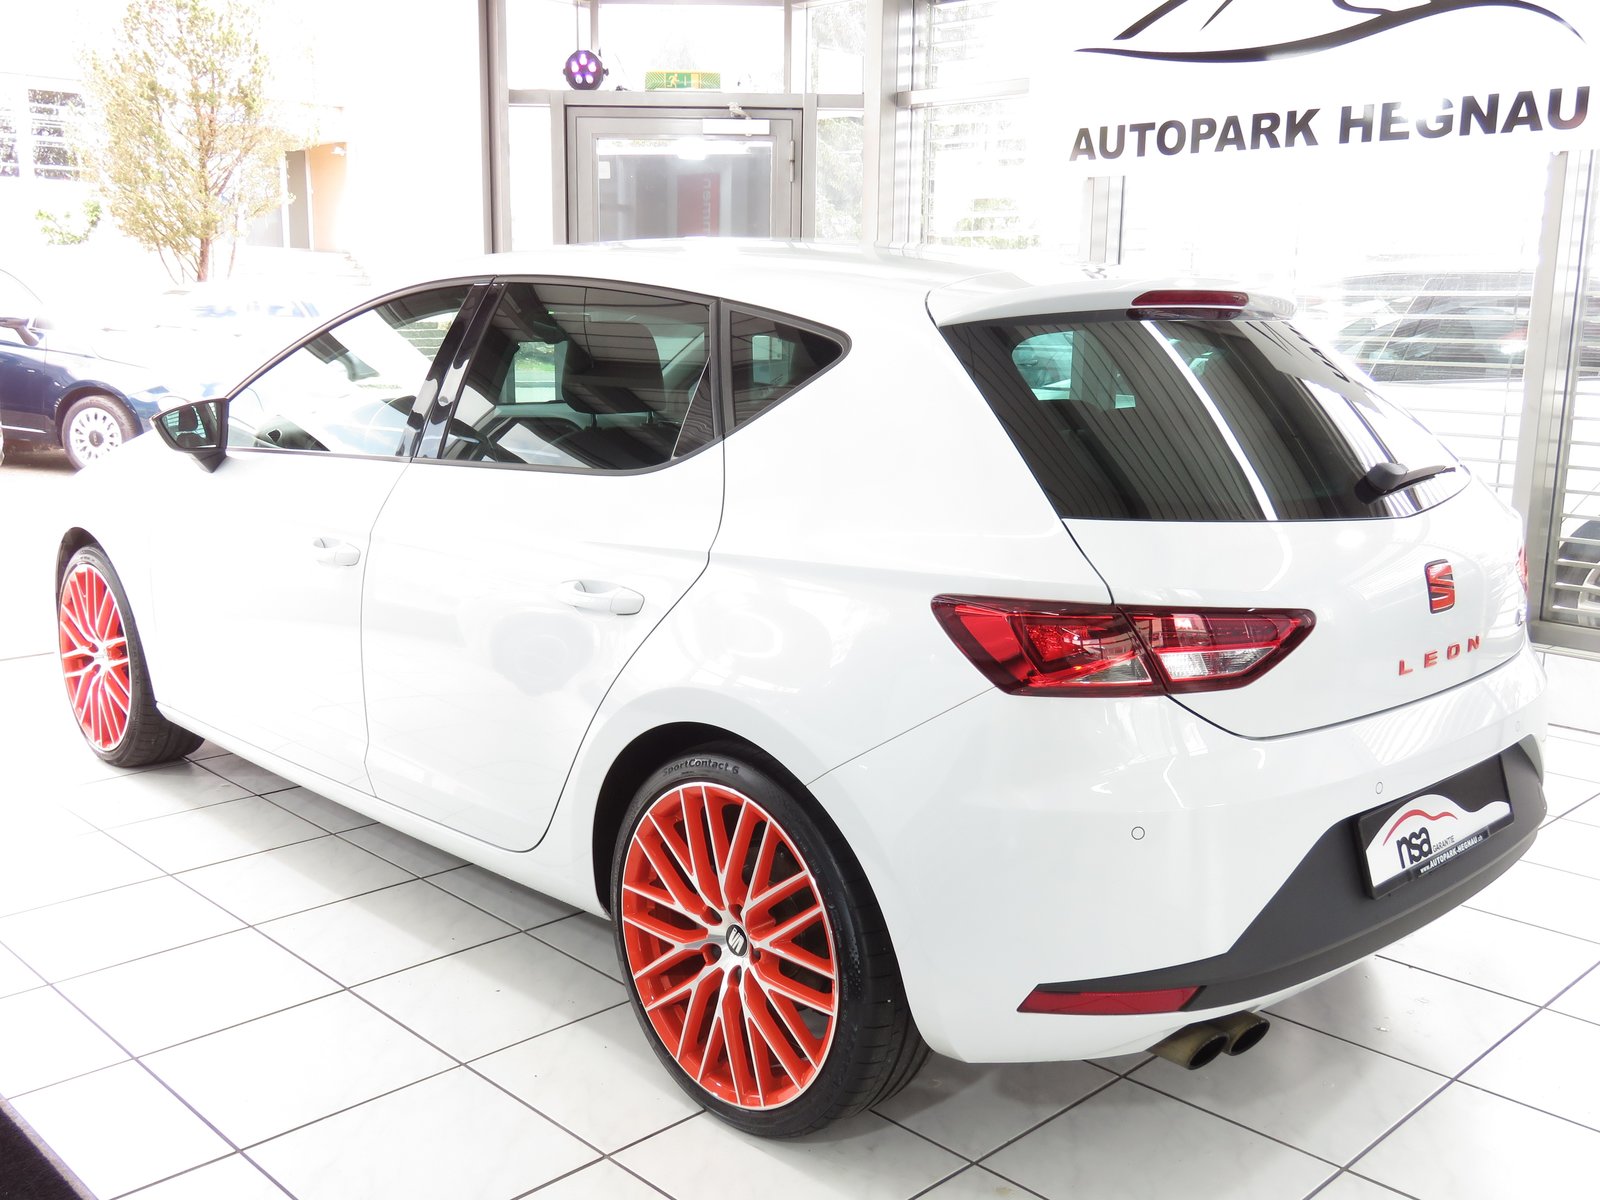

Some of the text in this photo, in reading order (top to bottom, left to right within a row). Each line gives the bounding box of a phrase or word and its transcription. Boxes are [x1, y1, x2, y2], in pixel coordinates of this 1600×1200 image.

[1069, 86, 1590, 161] AUTOPARK HEGNAU
[1398, 635, 1480, 676] LEON
[663, 758, 740, 777] SportContact 6
[1396, 826, 1432, 869] nsa
[1432, 835, 1455, 853] GARANTIE
